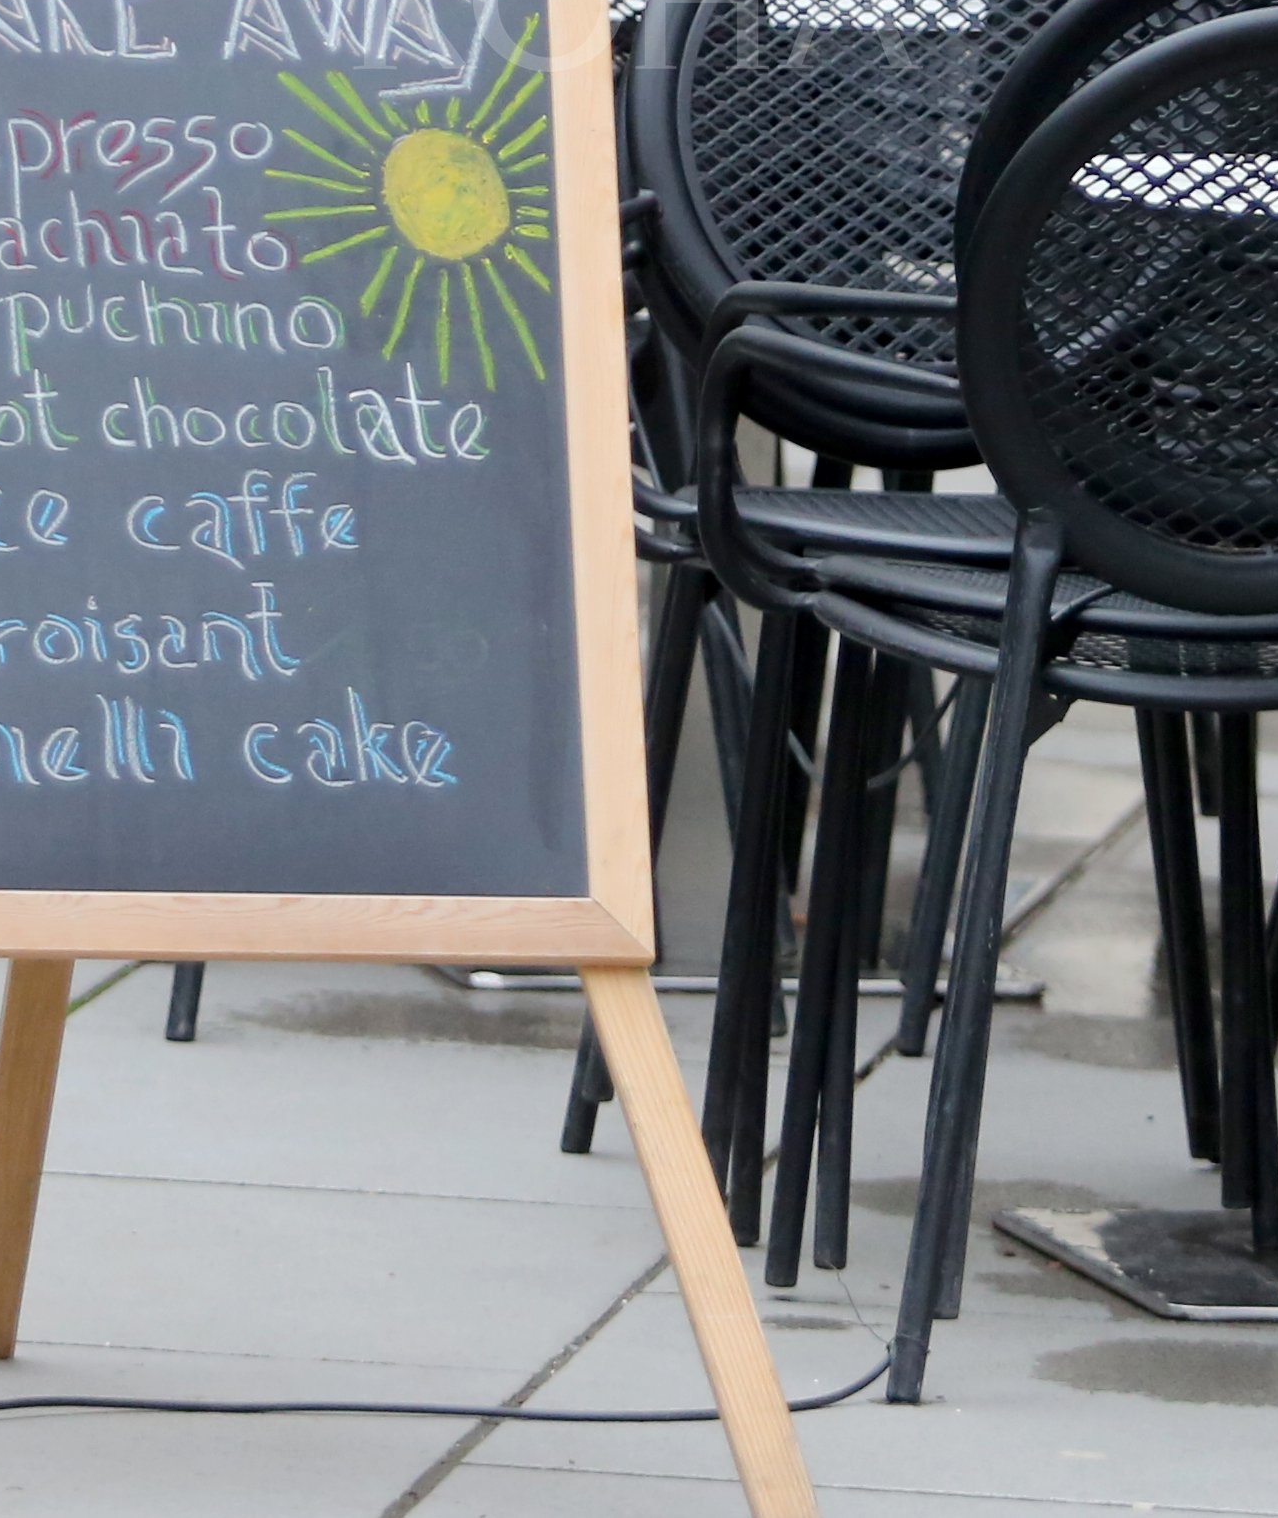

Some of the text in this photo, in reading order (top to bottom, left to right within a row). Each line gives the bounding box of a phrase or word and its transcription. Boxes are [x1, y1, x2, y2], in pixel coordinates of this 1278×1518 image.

[102, 362, 492, 465] chocolate
[127, 469, 360, 570] caffe
[243, 686, 458, 789] cake
